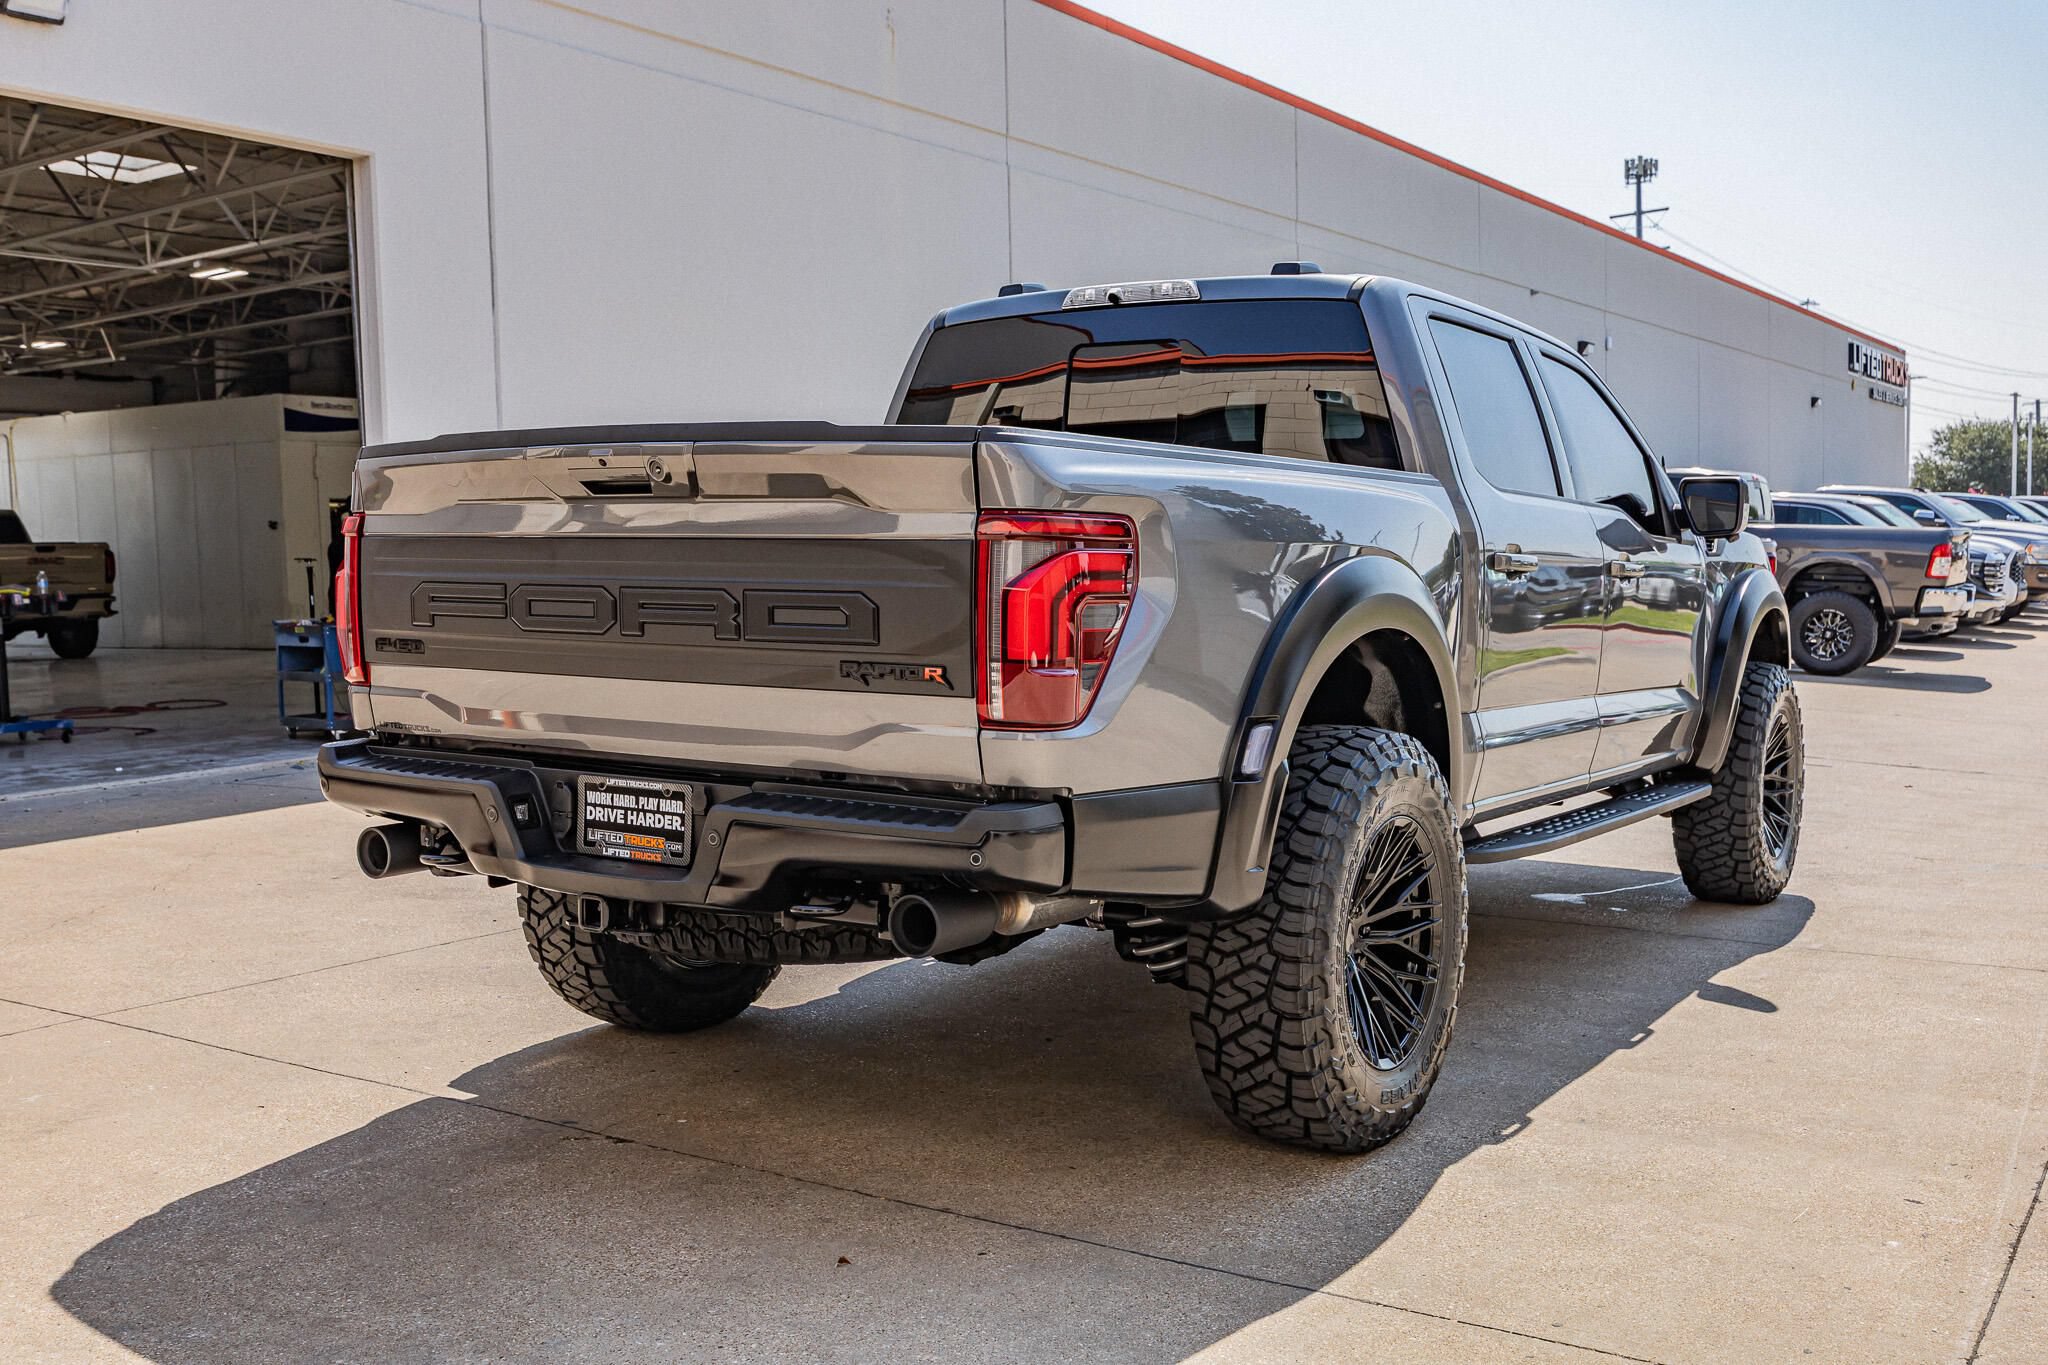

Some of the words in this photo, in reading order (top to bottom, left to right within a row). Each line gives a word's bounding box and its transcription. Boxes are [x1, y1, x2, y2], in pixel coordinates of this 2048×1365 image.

[411, 581, 880, 646] FORD
[840, 660, 954, 691] RAPTOR
[586, 790, 612, 806] WORK
[613, 793, 638, 809] HARD.
[639, 796, 658, 811] PLAY
[660, 798, 685, 814] HARD.
[586, 805, 625, 824] DRIVE
[627, 810, 685, 831] HARDER.
[603, 848, 630, 858] LIFTED
[630, 850, 662, 862] TRUCKS
